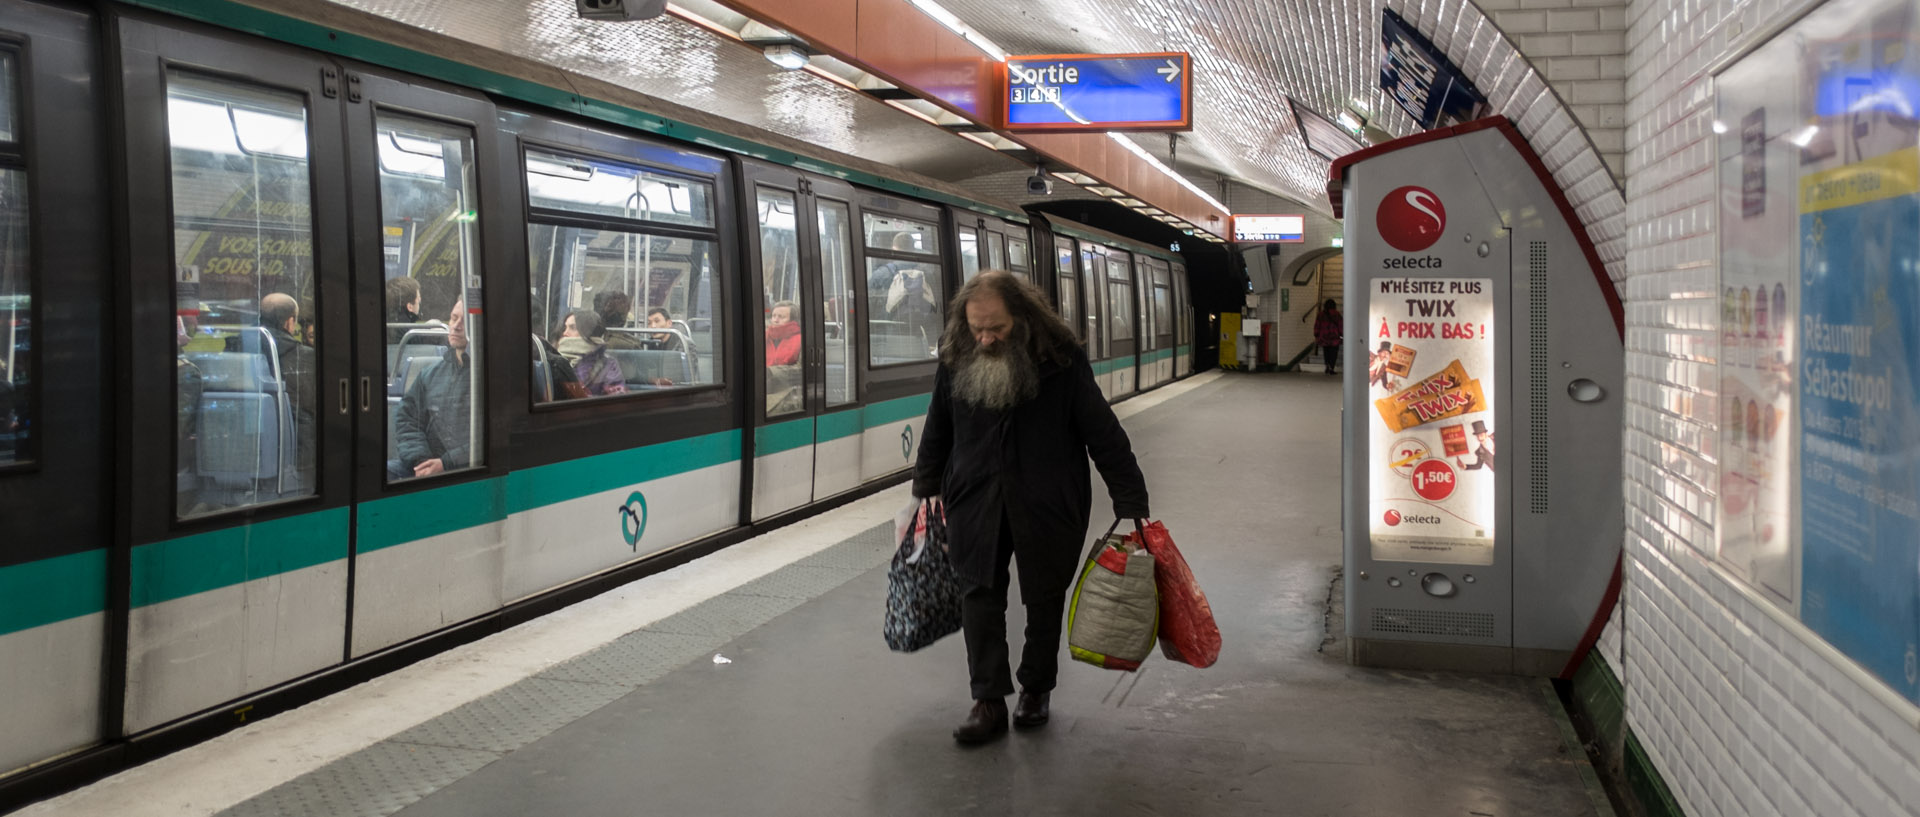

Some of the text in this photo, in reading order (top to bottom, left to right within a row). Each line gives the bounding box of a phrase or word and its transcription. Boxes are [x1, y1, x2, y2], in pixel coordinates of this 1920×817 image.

[1010, 63, 1078, 84] Sortie
[1386, 80, 1426, 122] Gare
[203, 257, 254, 275] SOUS
[1383, 255, 1442, 269] selecta
[1381, 278, 1482, 294] N'HÉSITEZ PLUS
[1405, 299, 1456, 317] TWIX
[1379, 317, 1485, 340] À PRIX BAS !
[1804, 313, 1873, 357] Réaumur
[1804, 357, 1892, 417] Sébastopol
[1414, 471, 1453, 490] 1,50€
[1403, 514, 1441, 525] selecta
